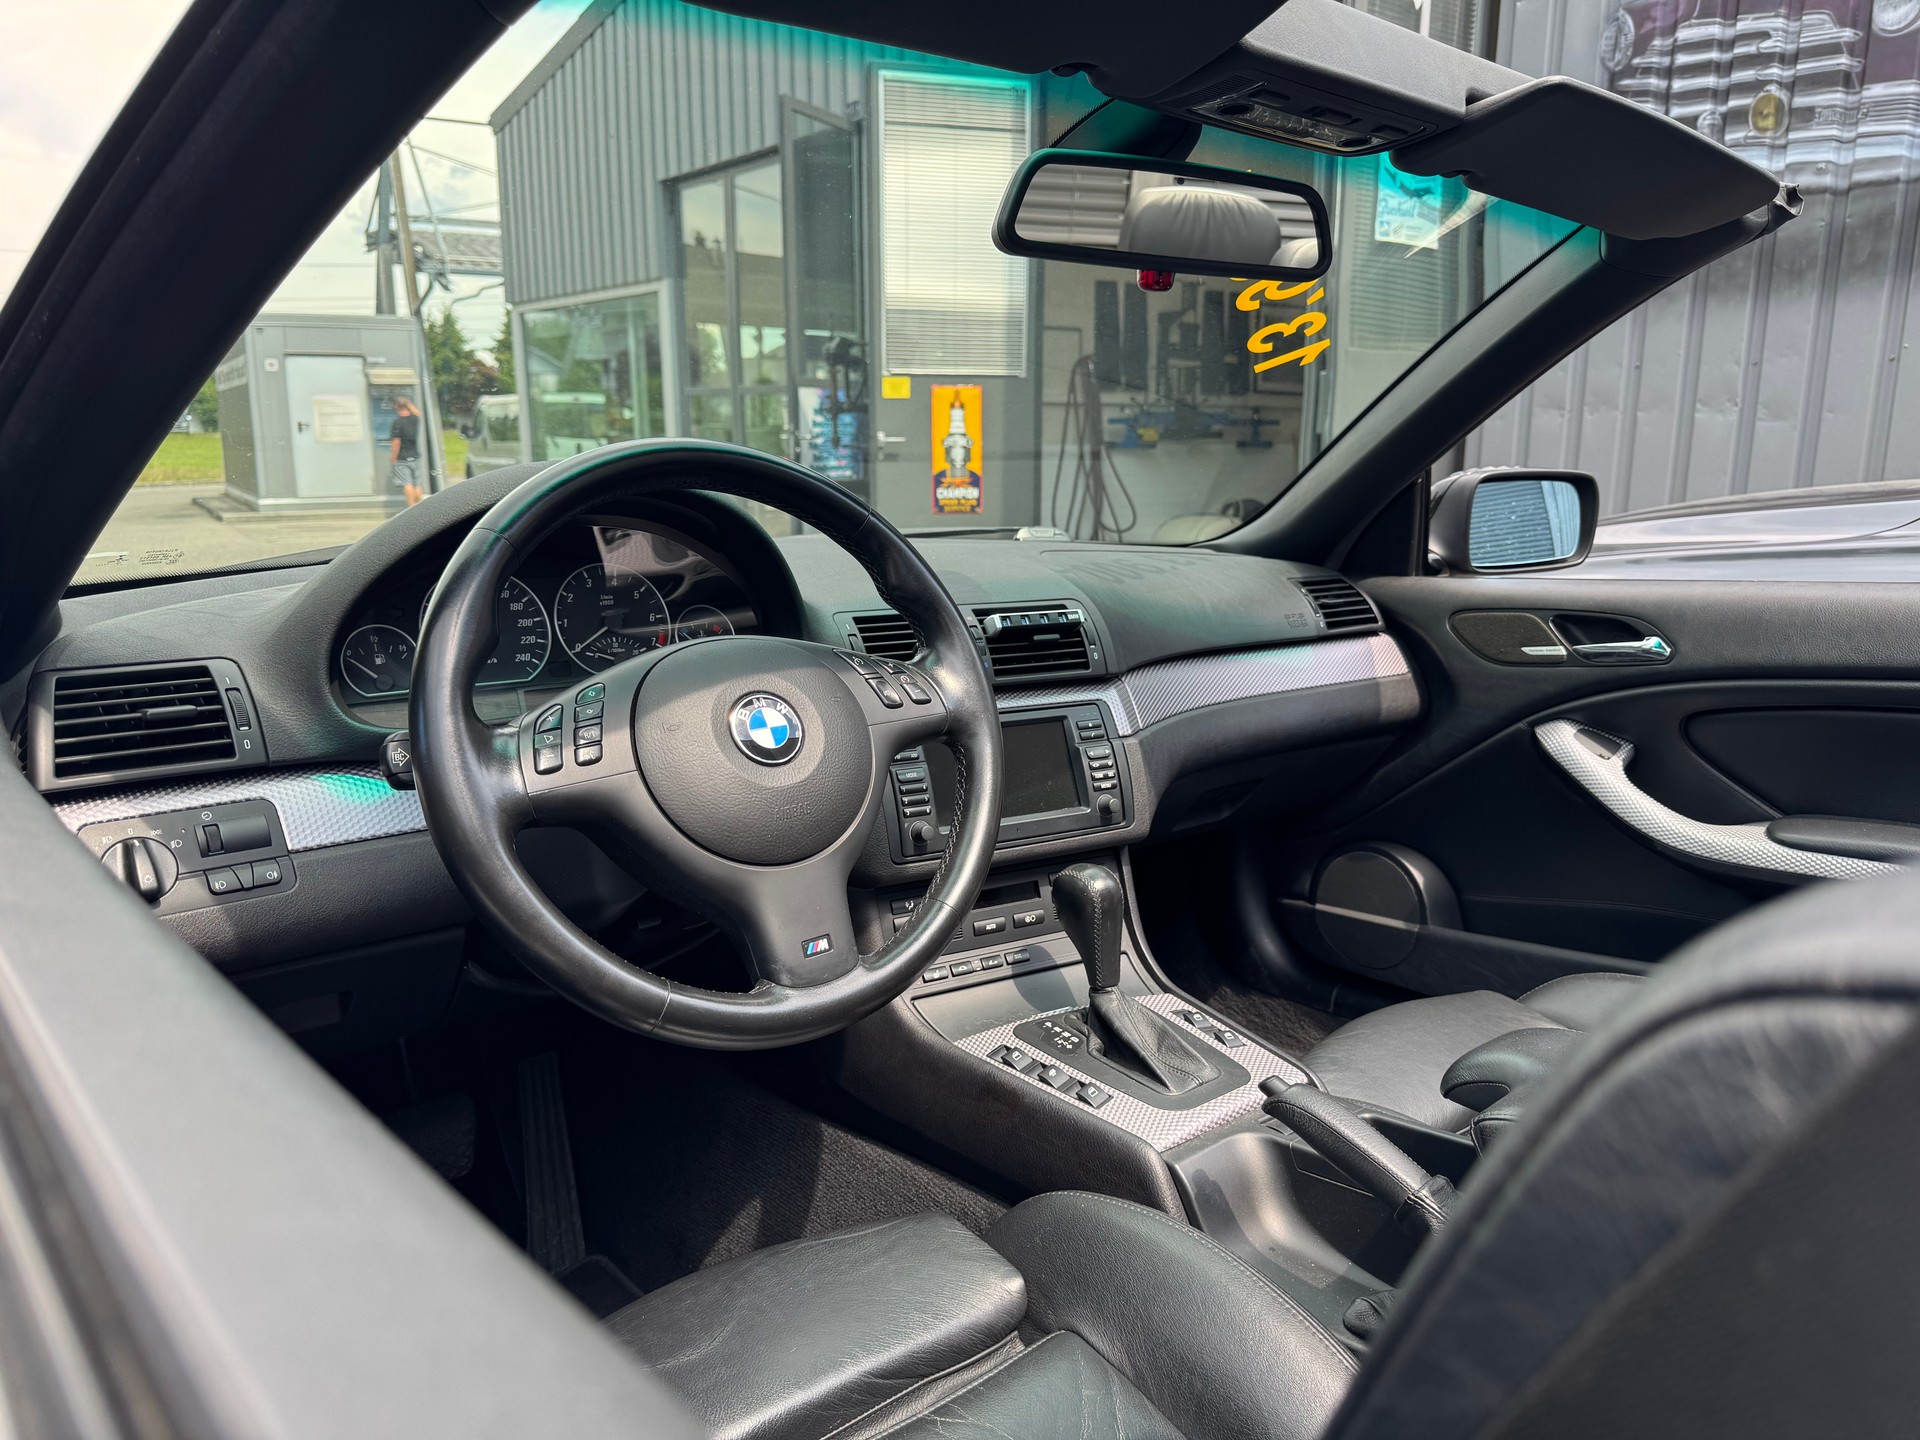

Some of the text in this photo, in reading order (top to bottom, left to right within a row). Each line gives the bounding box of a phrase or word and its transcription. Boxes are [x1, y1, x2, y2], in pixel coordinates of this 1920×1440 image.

[586, 579, 592, 588] 3
[611, 578, 618, 587] 4
[567, 593, 574, 603] 2
[633, 590, 640, 600] 5
[509, 602, 524, 611] 180
[649, 613, 656, 622] 6
[517, 618, 533, 628] 200
[563, 618, 568, 628] 1
[520, 635, 536, 645] 220
[651, 637, 657, 647] 7
[575, 642, 582, 652] 0
[515, 653, 531, 662] 240
[737, 697, 789, 721] BMW
[395, 753, 405, 761] BC
